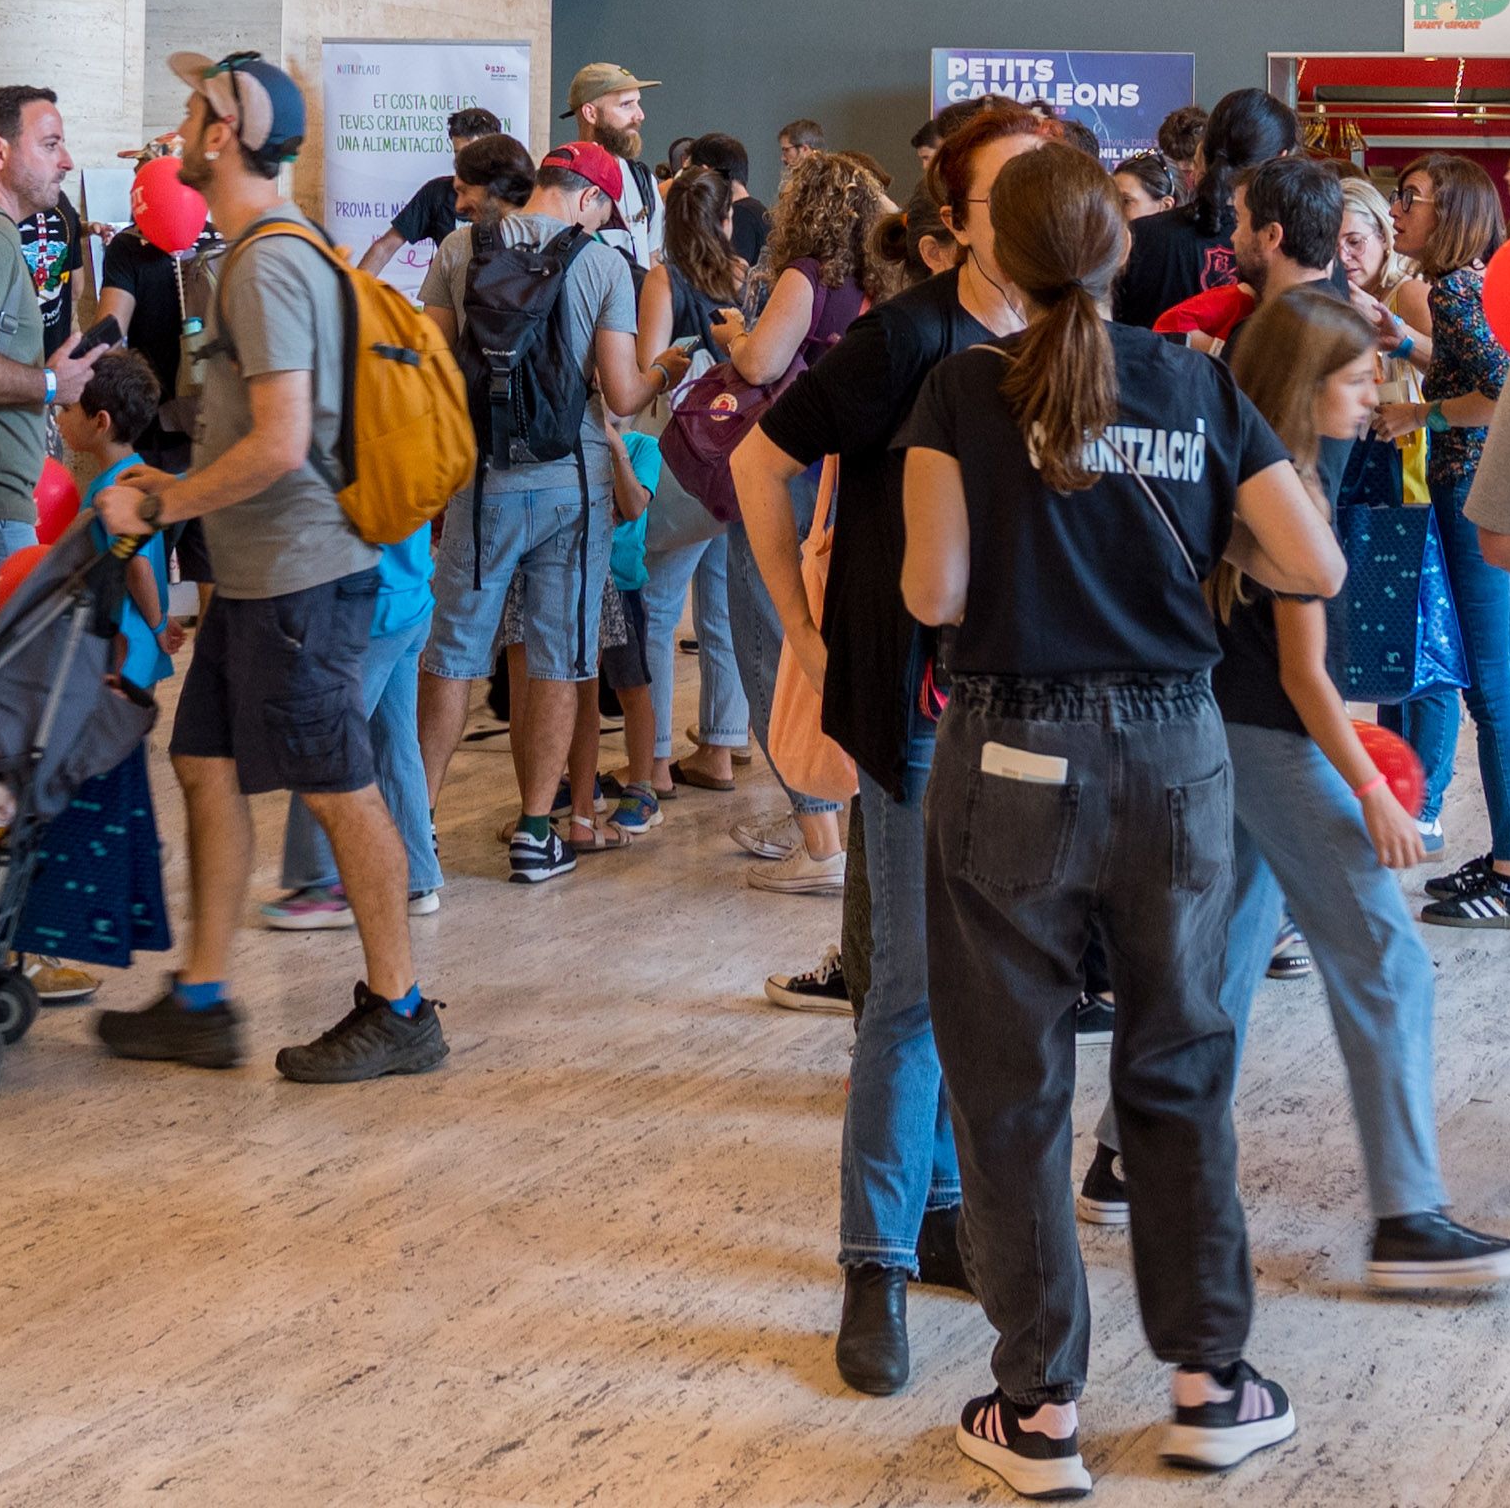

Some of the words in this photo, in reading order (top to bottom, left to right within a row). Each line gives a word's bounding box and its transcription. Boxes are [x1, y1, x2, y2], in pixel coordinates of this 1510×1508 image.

[336, 63, 381, 76] NUTRIPLATO
[947, 58, 1055, 82] PETITS
[373, 94, 388, 110] ET
[390, 94, 427, 110] COSTA
[430, 94, 455, 111] QUE
[457, 95, 477, 110] LES
[947, 80, 1140, 108] CAMALEONS
[339, 114, 374, 130] TEVES
[377, 114, 444, 133] CRIATURES
[336, 135, 360, 152] UNA
[362, 135, 443, 154] ALIMENTACIÓ
[335, 201, 372, 218] PROVA
[375, 202, 389, 218] EL
